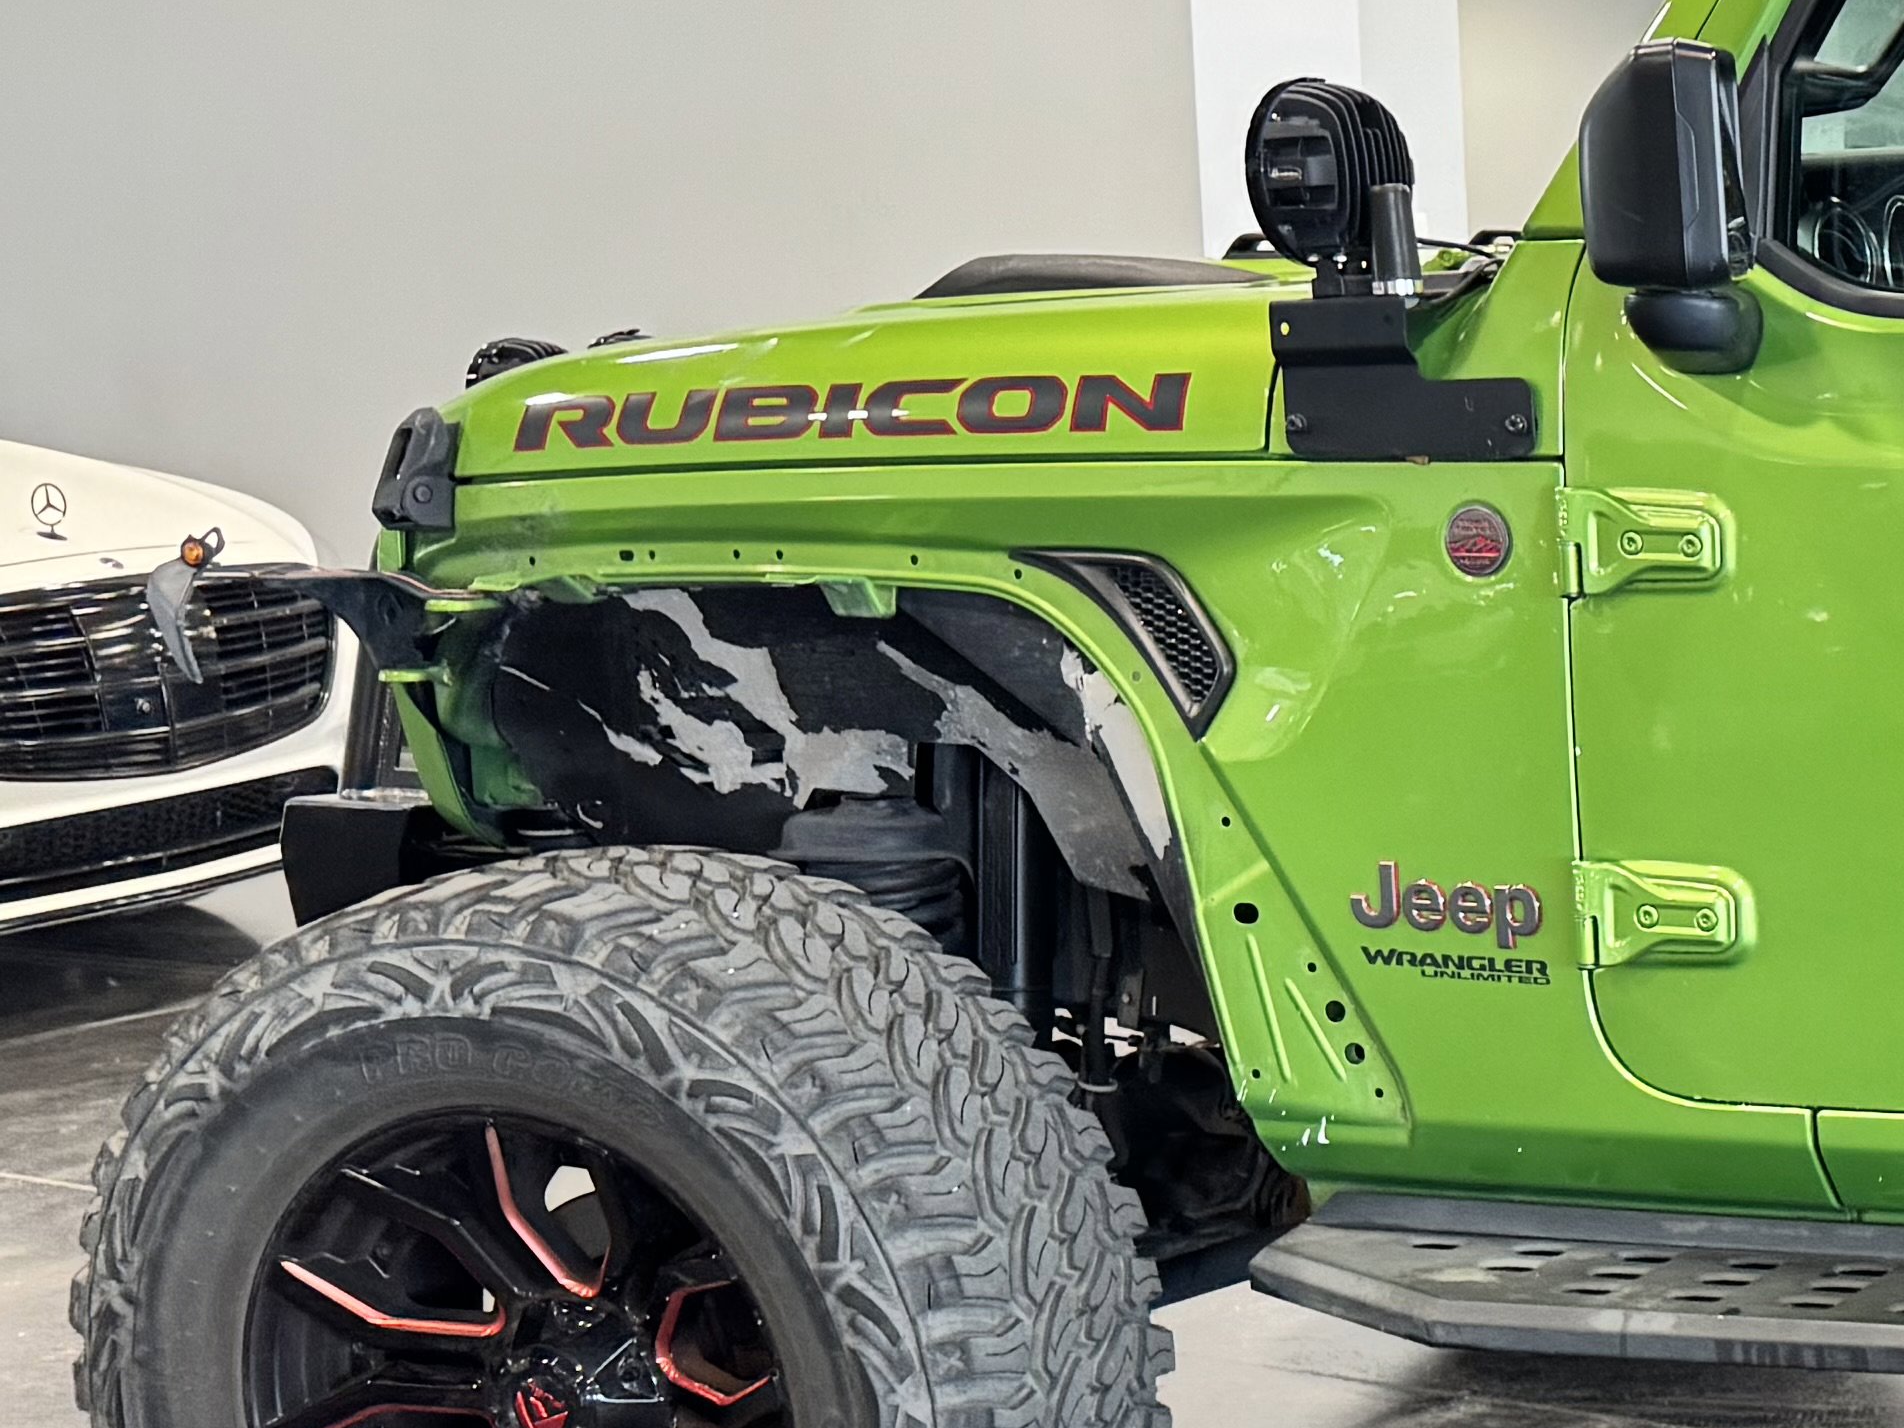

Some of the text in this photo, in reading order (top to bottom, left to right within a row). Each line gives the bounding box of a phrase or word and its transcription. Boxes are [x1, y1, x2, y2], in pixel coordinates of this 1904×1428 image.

[512, 372, 1192, 452] RUBICON
[1350, 860, 1543, 950] Jeep
[1360, 945, 1549, 977] WRANGLER
[1420, 968, 1551, 986] UNLIMITED
